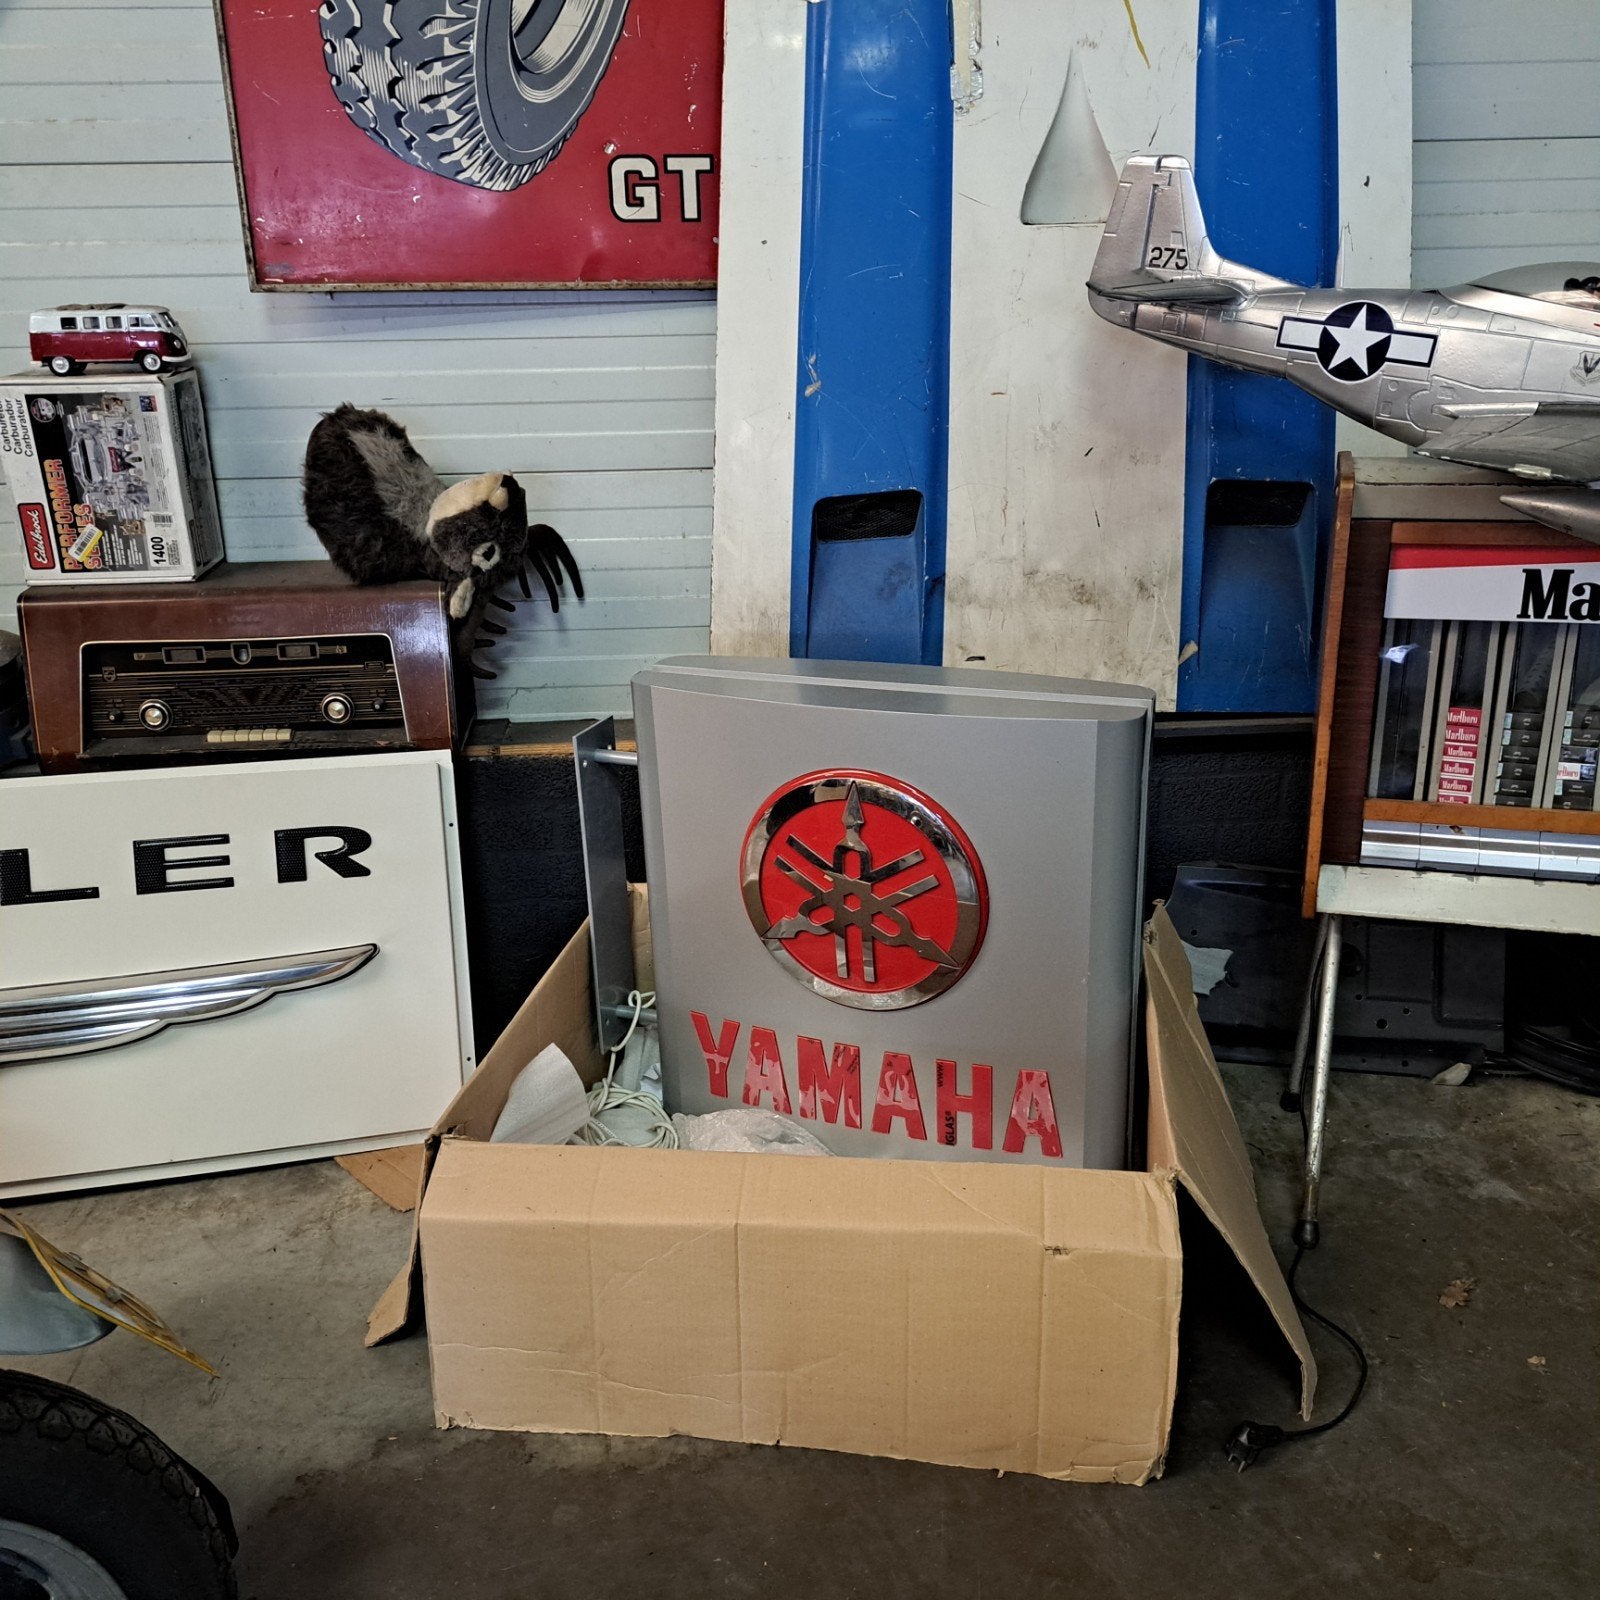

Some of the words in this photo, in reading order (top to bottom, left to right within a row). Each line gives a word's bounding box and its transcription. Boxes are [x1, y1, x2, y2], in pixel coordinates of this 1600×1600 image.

[607, 153, 714, 222] GT
[1149, 246, 1188, 270] 275
[5, 398, 23, 455] Carburador
[15, 398, 34, 457] Carburateur
[26, 509, 48, 564] Edelbrock
[151, 536, 166, 565] 1400
[1516, 568, 1600, 622] Ma
[1443, 762, 1470, 774] Marlboro
[1447, 746, 1473, 757] Marlboro
[1442, 780, 1468, 791] Marlboro
[0, 825, 372, 906] LER
[690, 1010, 1063, 1158] YAMAHA
